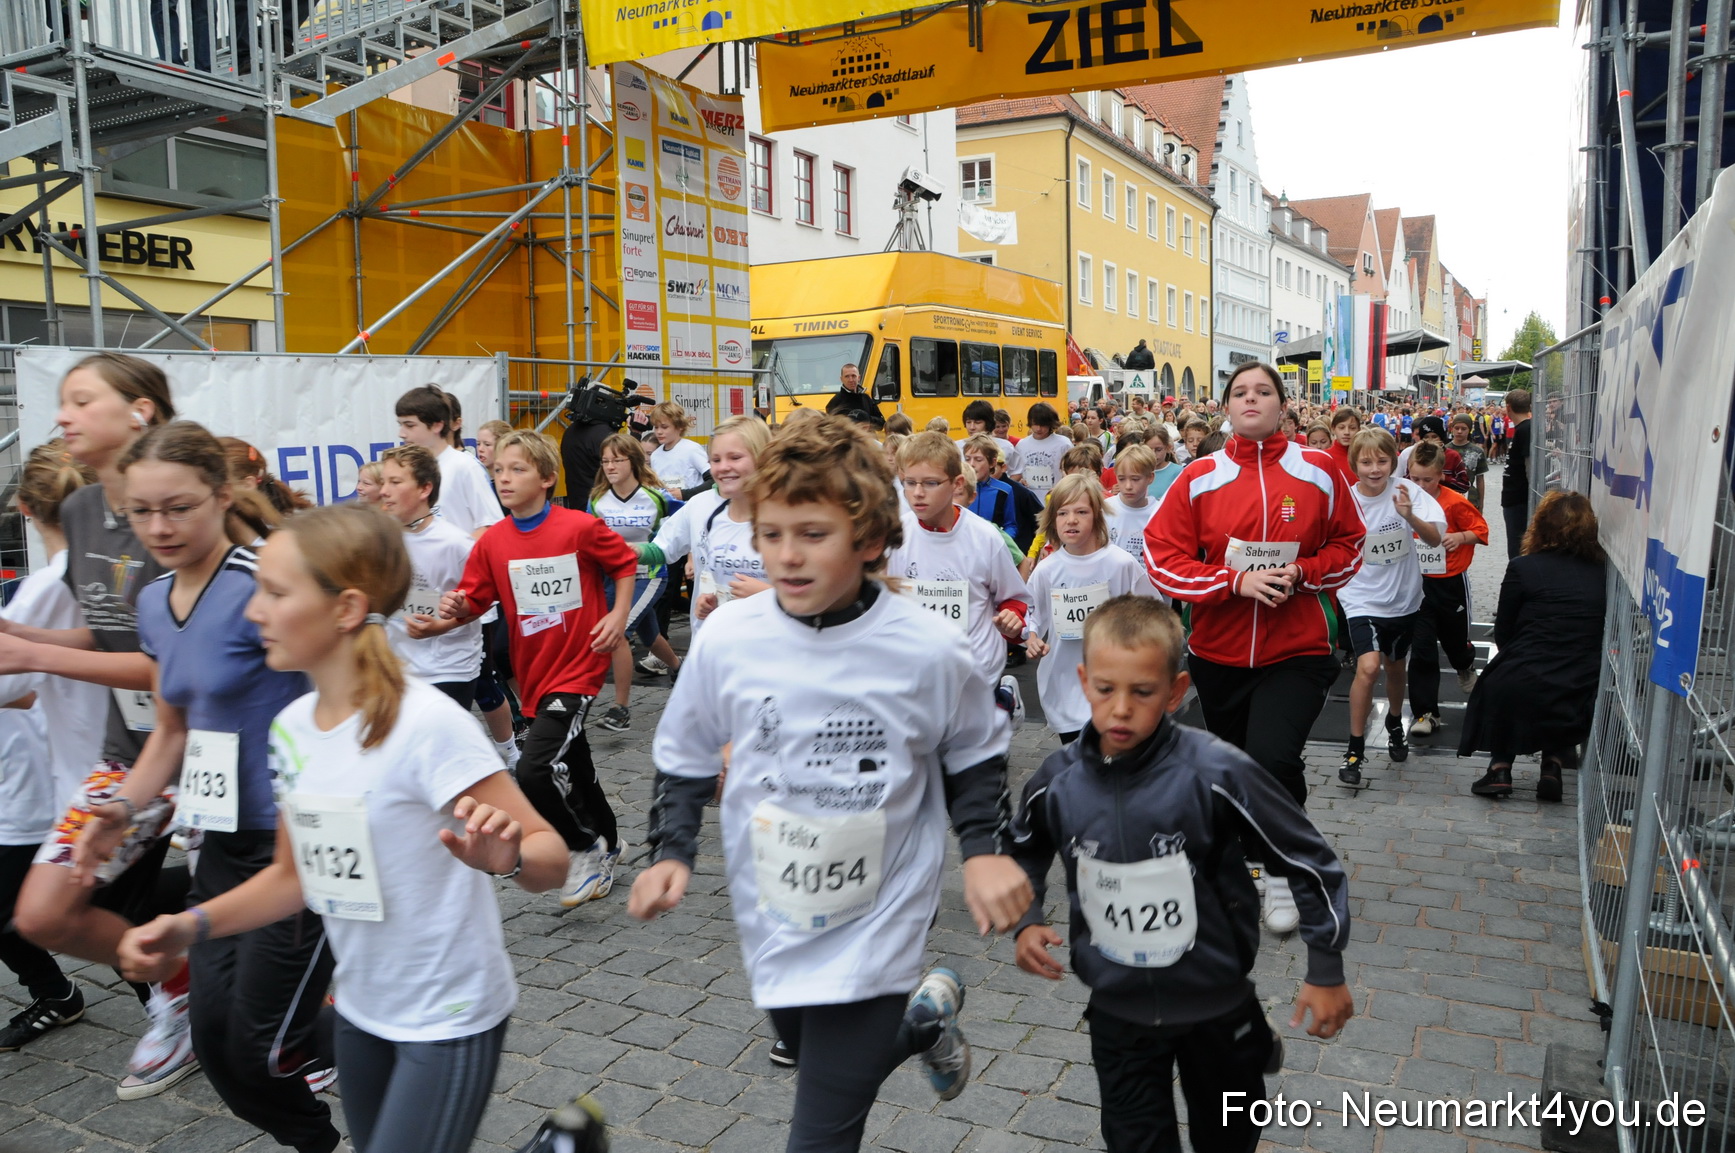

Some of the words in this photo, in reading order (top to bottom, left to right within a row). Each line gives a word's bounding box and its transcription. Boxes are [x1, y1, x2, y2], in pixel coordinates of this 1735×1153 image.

[1025, 0, 1204, 75] ZIEL
[789, 77, 869, 98] Neumarkter
[871, 64, 936, 86] Stadtlauf
[701, 109, 745, 130] MERZ
[627, 158, 644, 169] KANN
[622, 227, 654, 245] Sinupret
[713, 226, 748, 248] OBI
[623, 243, 643, 257] forte
[793, 319, 850, 333] TIMING
[1011, 326, 1024, 336] EVENT
[1025, 328, 1043, 339] SERVICE
[627, 352, 661, 361] HACKNER
[675, 394, 710, 411] Sinupret
[604, 515, 652, 527] BOCK
[1245, 546, 1281, 557] Sabrina
[1371, 540, 1403, 555] 4137
[525, 564, 555, 576] Stefan
[531, 577, 573, 597] 4027
[917, 585, 963, 597] Maximilian
[1063, 593, 1088, 603] Marco
[1066, 605, 1098, 623] 405
[184, 767, 227, 798] 4133
[777, 821, 821, 850] Felix
[302, 841, 365, 880] 4132
[780, 856, 868, 895] 4054
[1105, 899, 1184, 934] 4128
